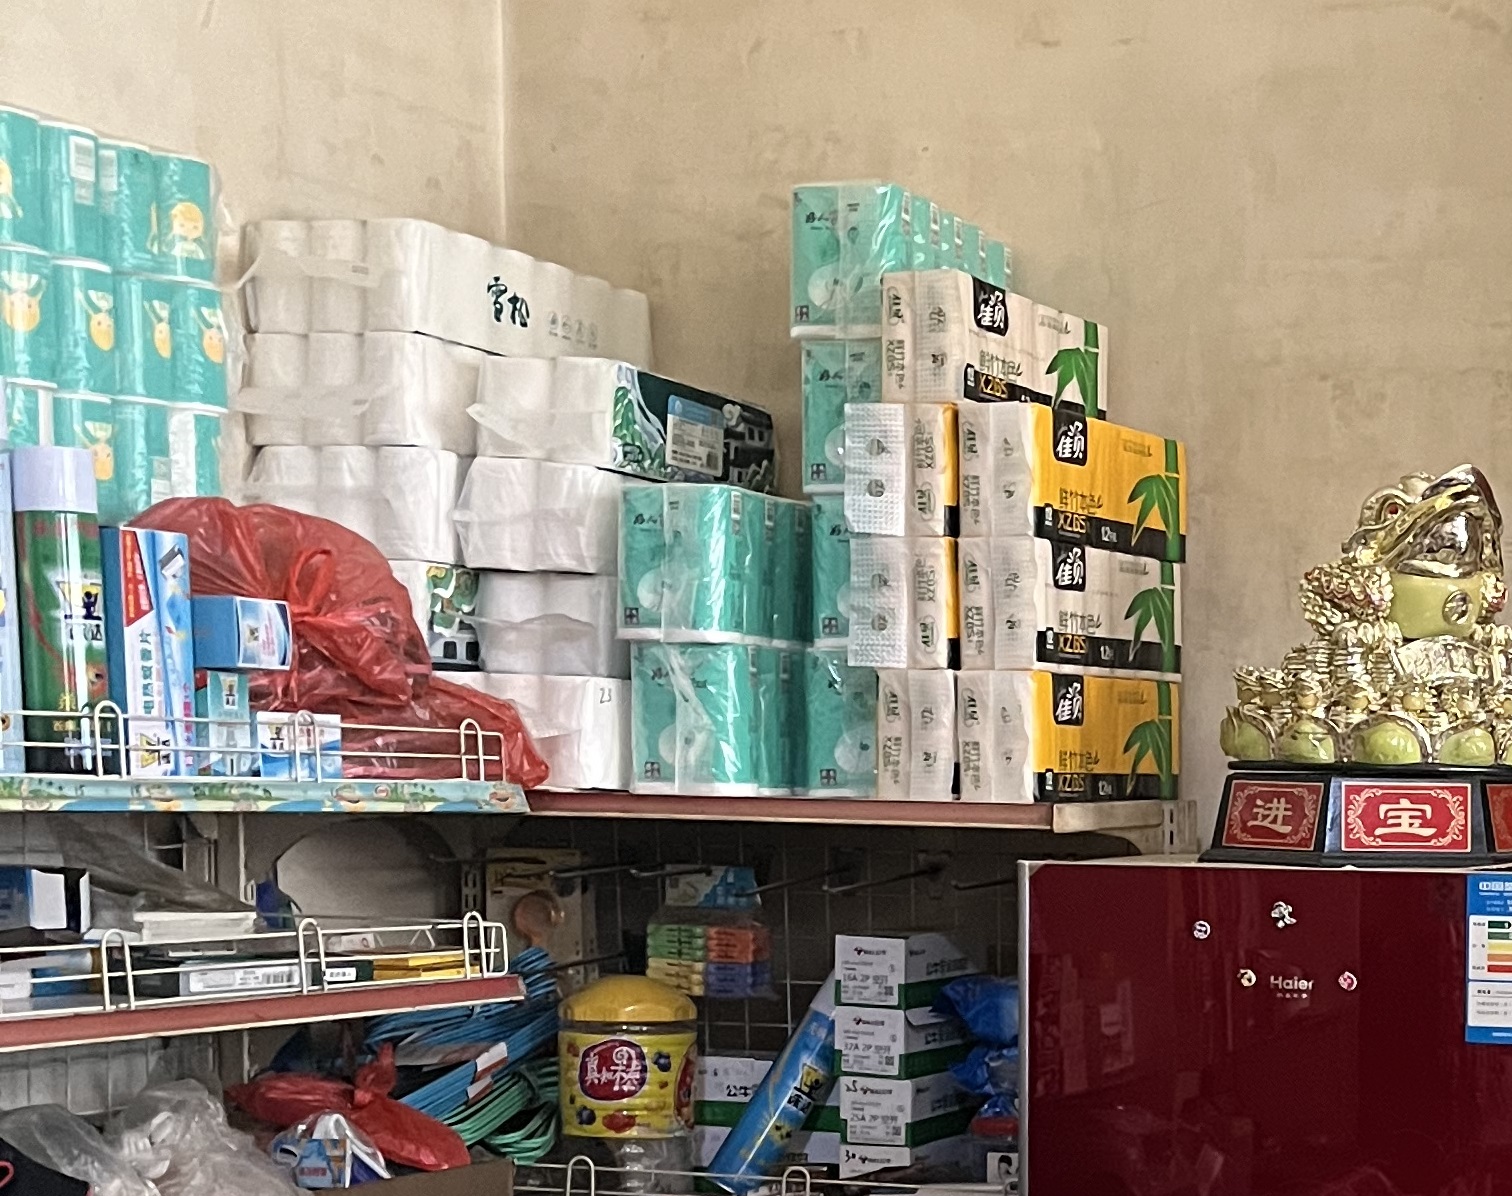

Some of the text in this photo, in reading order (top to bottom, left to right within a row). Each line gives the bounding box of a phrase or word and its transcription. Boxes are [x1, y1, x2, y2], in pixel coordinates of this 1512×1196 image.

[1246, 797, 1293, 835] 进
[1373, 798, 1437, 838] 宝
[1270, 975, 1315, 991] Haier
